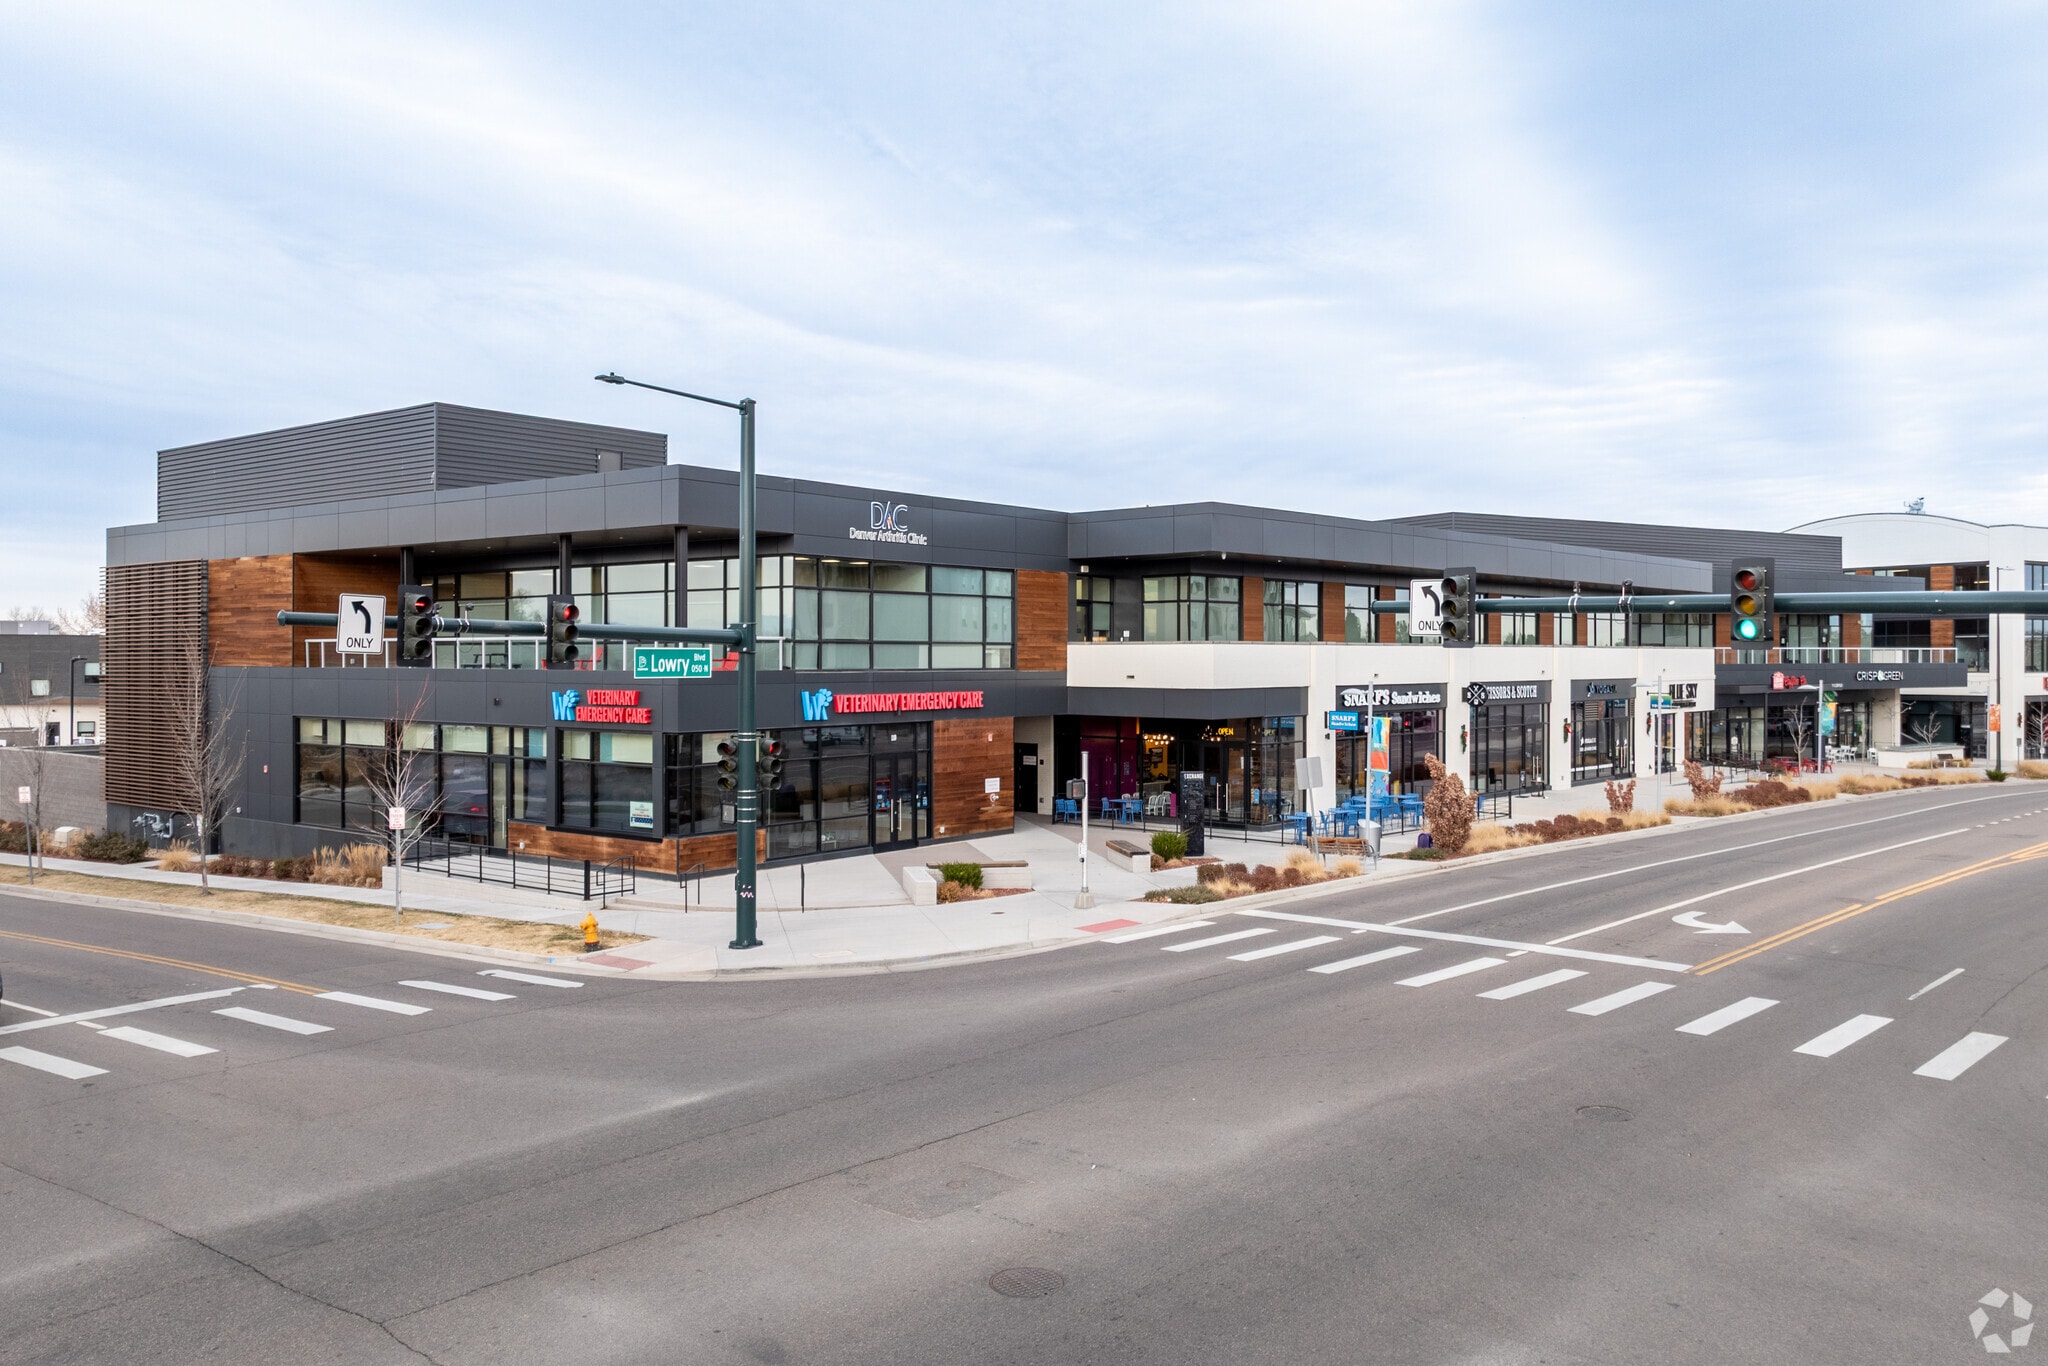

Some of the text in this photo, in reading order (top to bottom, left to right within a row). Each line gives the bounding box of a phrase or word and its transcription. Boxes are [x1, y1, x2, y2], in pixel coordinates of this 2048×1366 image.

[871, 501, 908, 531] DAC
[849, 527, 928, 545] Denver Arthritis Clinic
[1418, 620, 1443, 631] ONLY
[346, 636, 373, 648] ONLY
[651, 653, 706, 677] Lowry Blvd
[691, 664, 703, 673] 050
[586, 689, 639, 706] VETERINARY
[1391, 690, 1441, 705] Sandwiches
[1511, 685, 1517, 699] &
[1516, 685, 1538, 699] SCOTCH
[1685, 683, 1698, 699] SKY
[834, 690, 984, 713] VETERINARY EMERGENCY CARE
[576, 706, 651, 724] EMERGENCY CARE
[1218, 727, 1234, 736] OPEN
